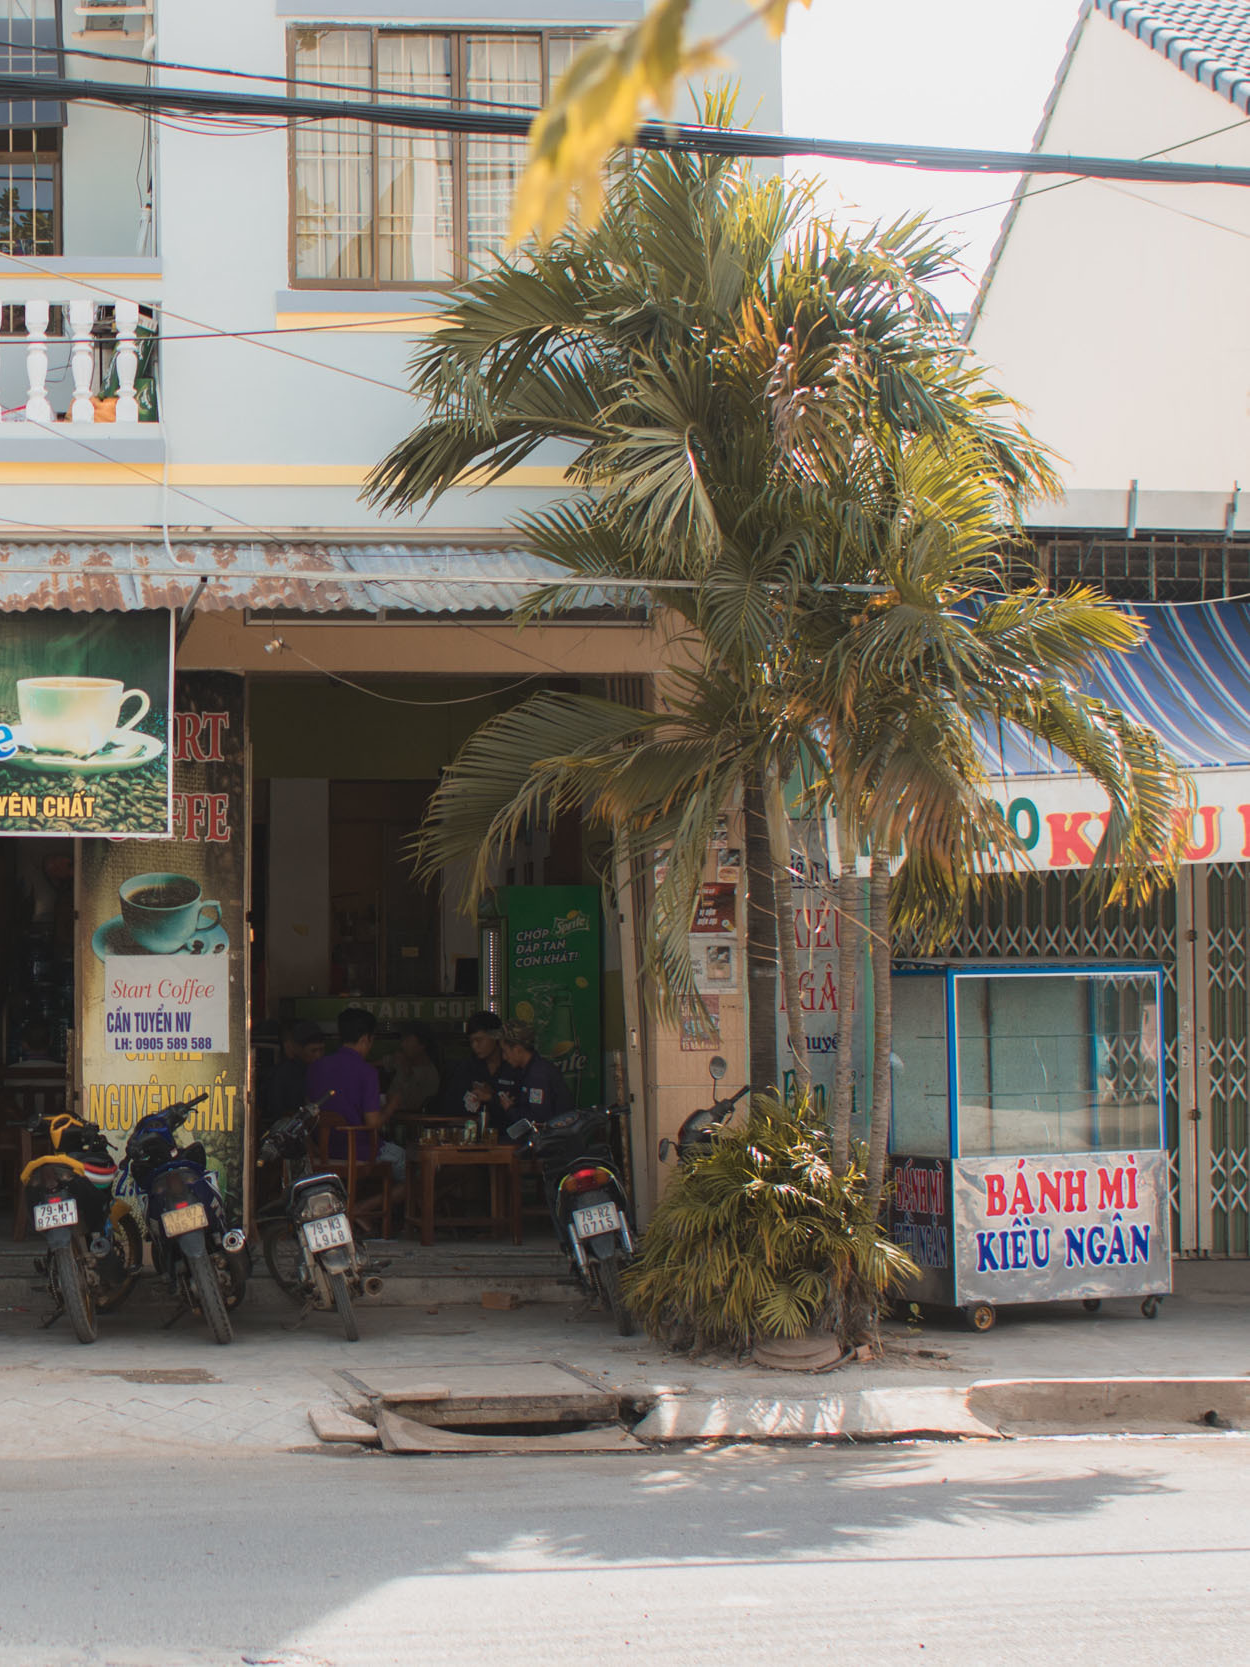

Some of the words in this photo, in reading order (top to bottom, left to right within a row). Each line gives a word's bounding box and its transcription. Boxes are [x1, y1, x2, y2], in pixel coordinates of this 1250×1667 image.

[42, 790, 95, 818] CHẤT
[111, 979, 152, 999] Start
[158, 979, 215, 1004] Coffee
[107, 1006, 131, 1033] CẦN
[134, 1004, 172, 1033] TUYỂN
[176, 1012, 192, 1033] NV
[115, 1038, 132, 1050] LH:
[136, 1038, 163, 1050] 0905
[167, 1038, 188, 1050] 589
[191, 1037, 212, 1050] 588
[985, 1158, 1087, 1217] BÁNH
[1097, 1153, 1139, 1211] MÌ
[583, 1217, 613, 1233] 0715
[976, 1216, 1051, 1273] KIỀU
[1064, 1212, 1151, 1268] NGÂN
